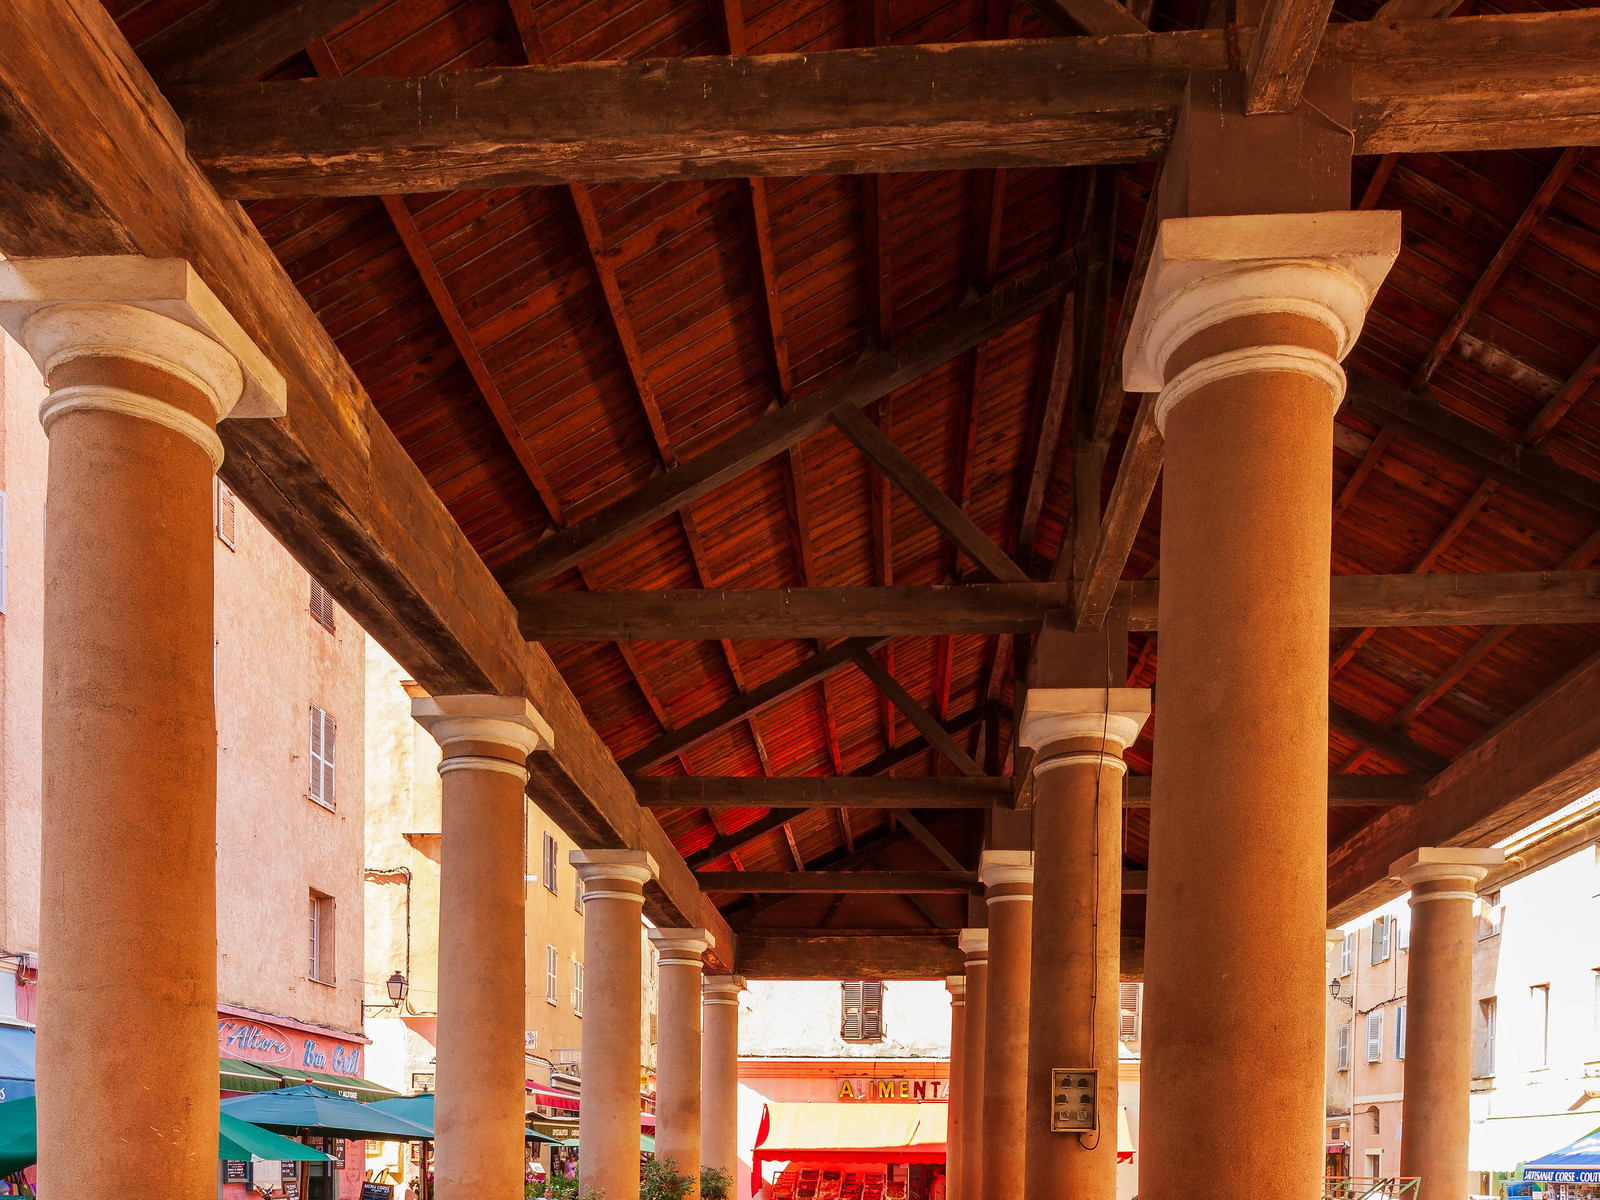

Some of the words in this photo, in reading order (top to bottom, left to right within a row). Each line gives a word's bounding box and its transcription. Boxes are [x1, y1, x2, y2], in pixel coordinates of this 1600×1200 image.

[303, 1038, 326, 1068] Bar
[333, 1045, 360, 1075] Grill
[1555, 1171, 1575, 1182] CORSE
